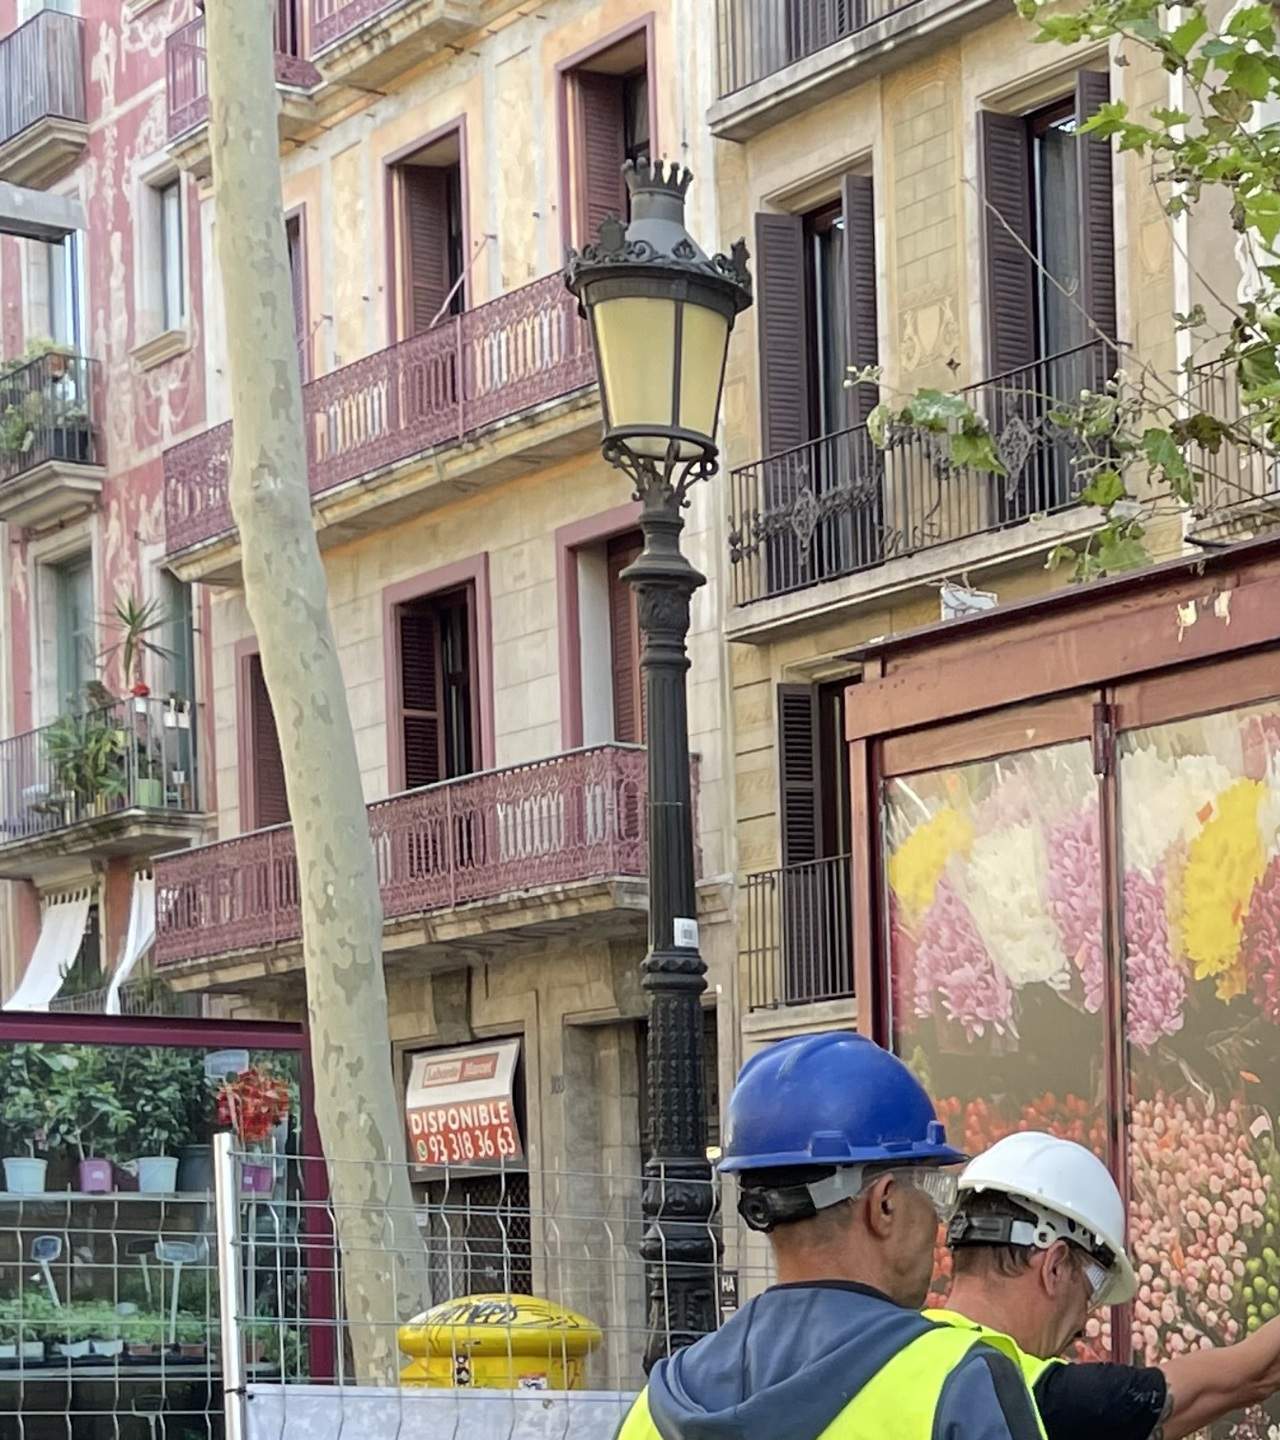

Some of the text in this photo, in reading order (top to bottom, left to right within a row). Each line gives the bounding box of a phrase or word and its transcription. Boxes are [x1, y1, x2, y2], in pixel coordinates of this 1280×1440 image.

[410, 1100, 511, 1136] DISPONIBLE
[429, 1125, 516, 1163] 93 318 36 63
